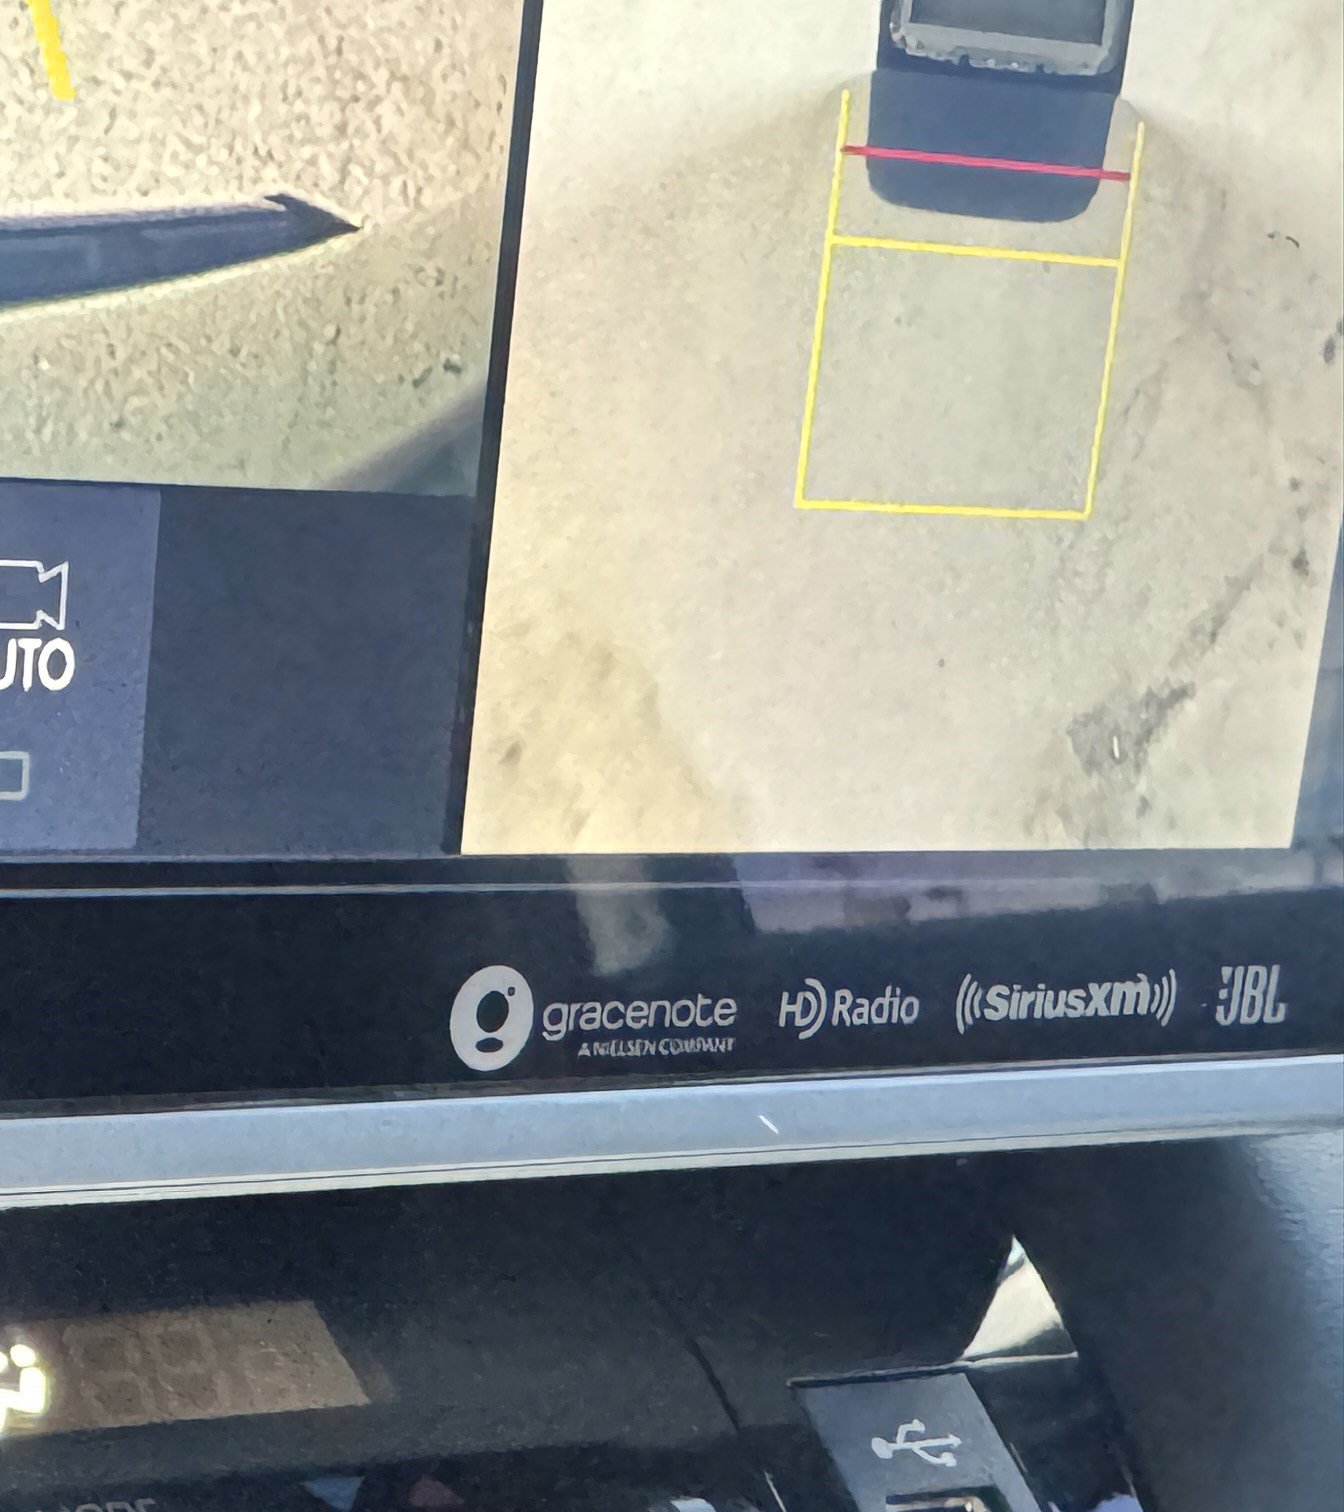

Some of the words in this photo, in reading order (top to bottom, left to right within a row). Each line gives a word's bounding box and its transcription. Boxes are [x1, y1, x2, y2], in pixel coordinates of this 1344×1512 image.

[542, 994, 738, 1041] gracenote
[832, 985, 919, 1026] Radio
[1215, 964, 1287, 1027] JBL
